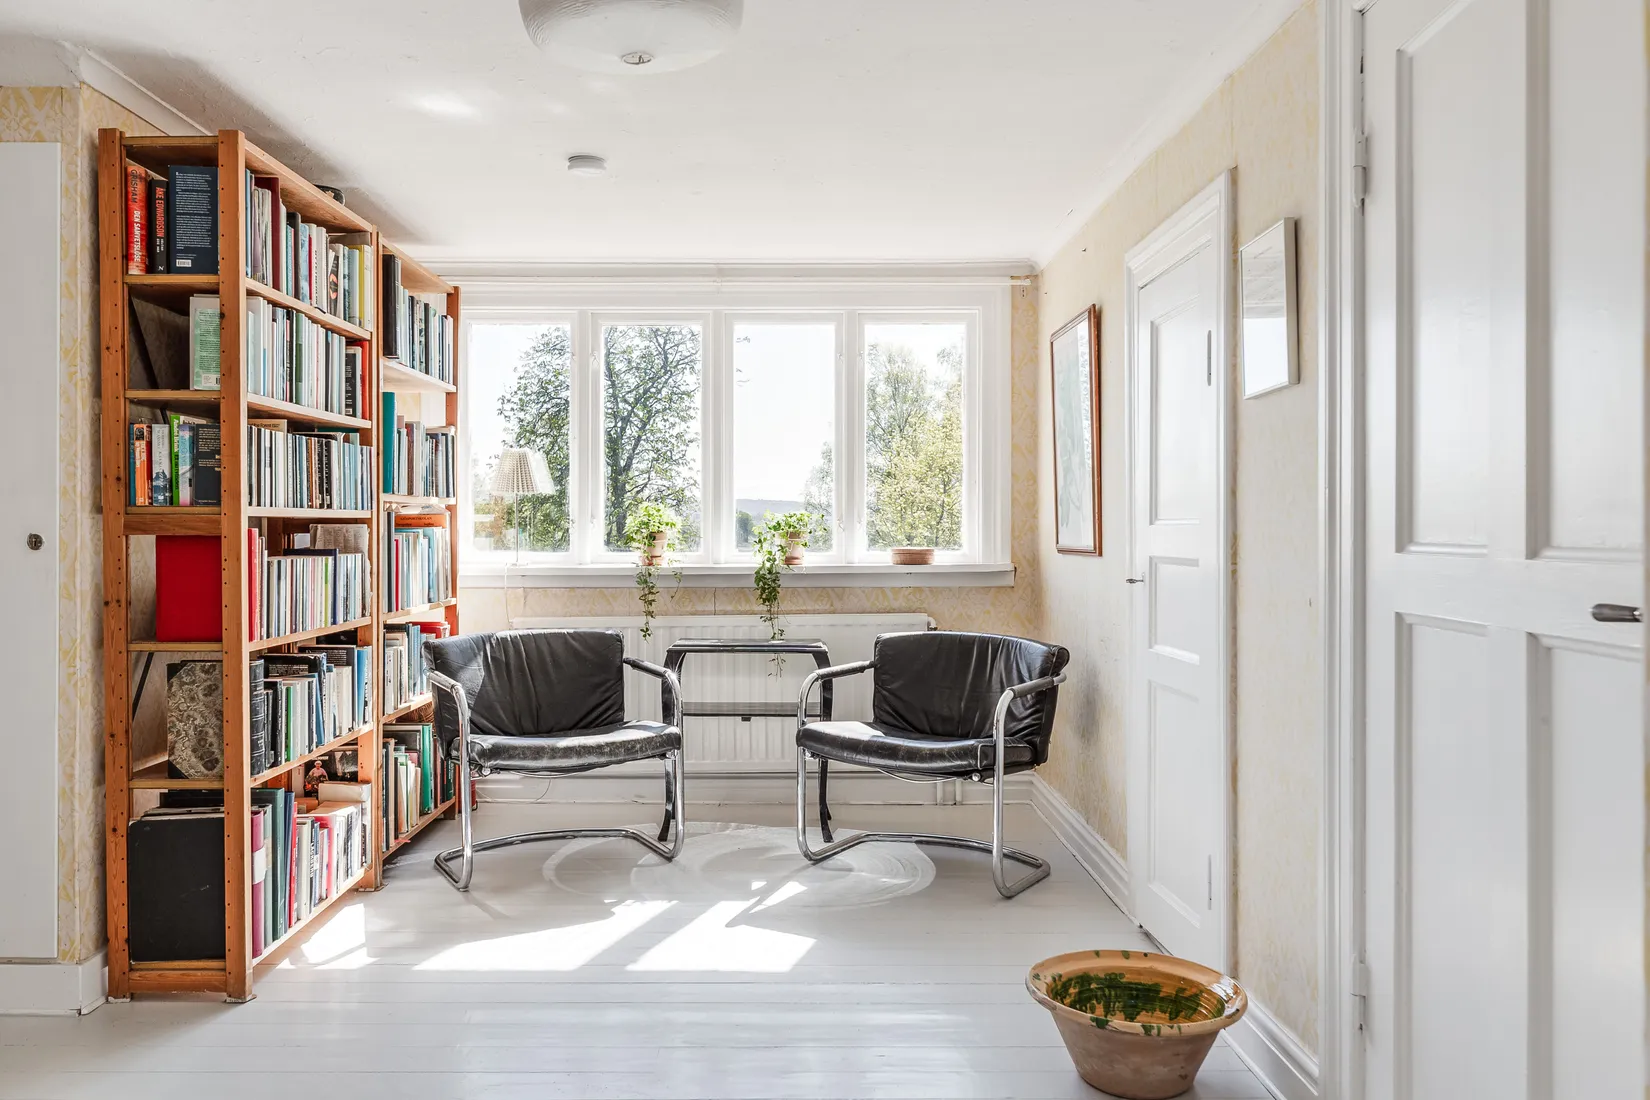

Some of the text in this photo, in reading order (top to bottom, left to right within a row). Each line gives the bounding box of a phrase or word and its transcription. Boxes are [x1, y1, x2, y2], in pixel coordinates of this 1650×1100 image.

[130, 169, 138, 204] GRISHAM
[156, 186, 166, 237] ÅKE EDWARDSON
[134, 223, 142, 262] SAMVETSLÖSE
